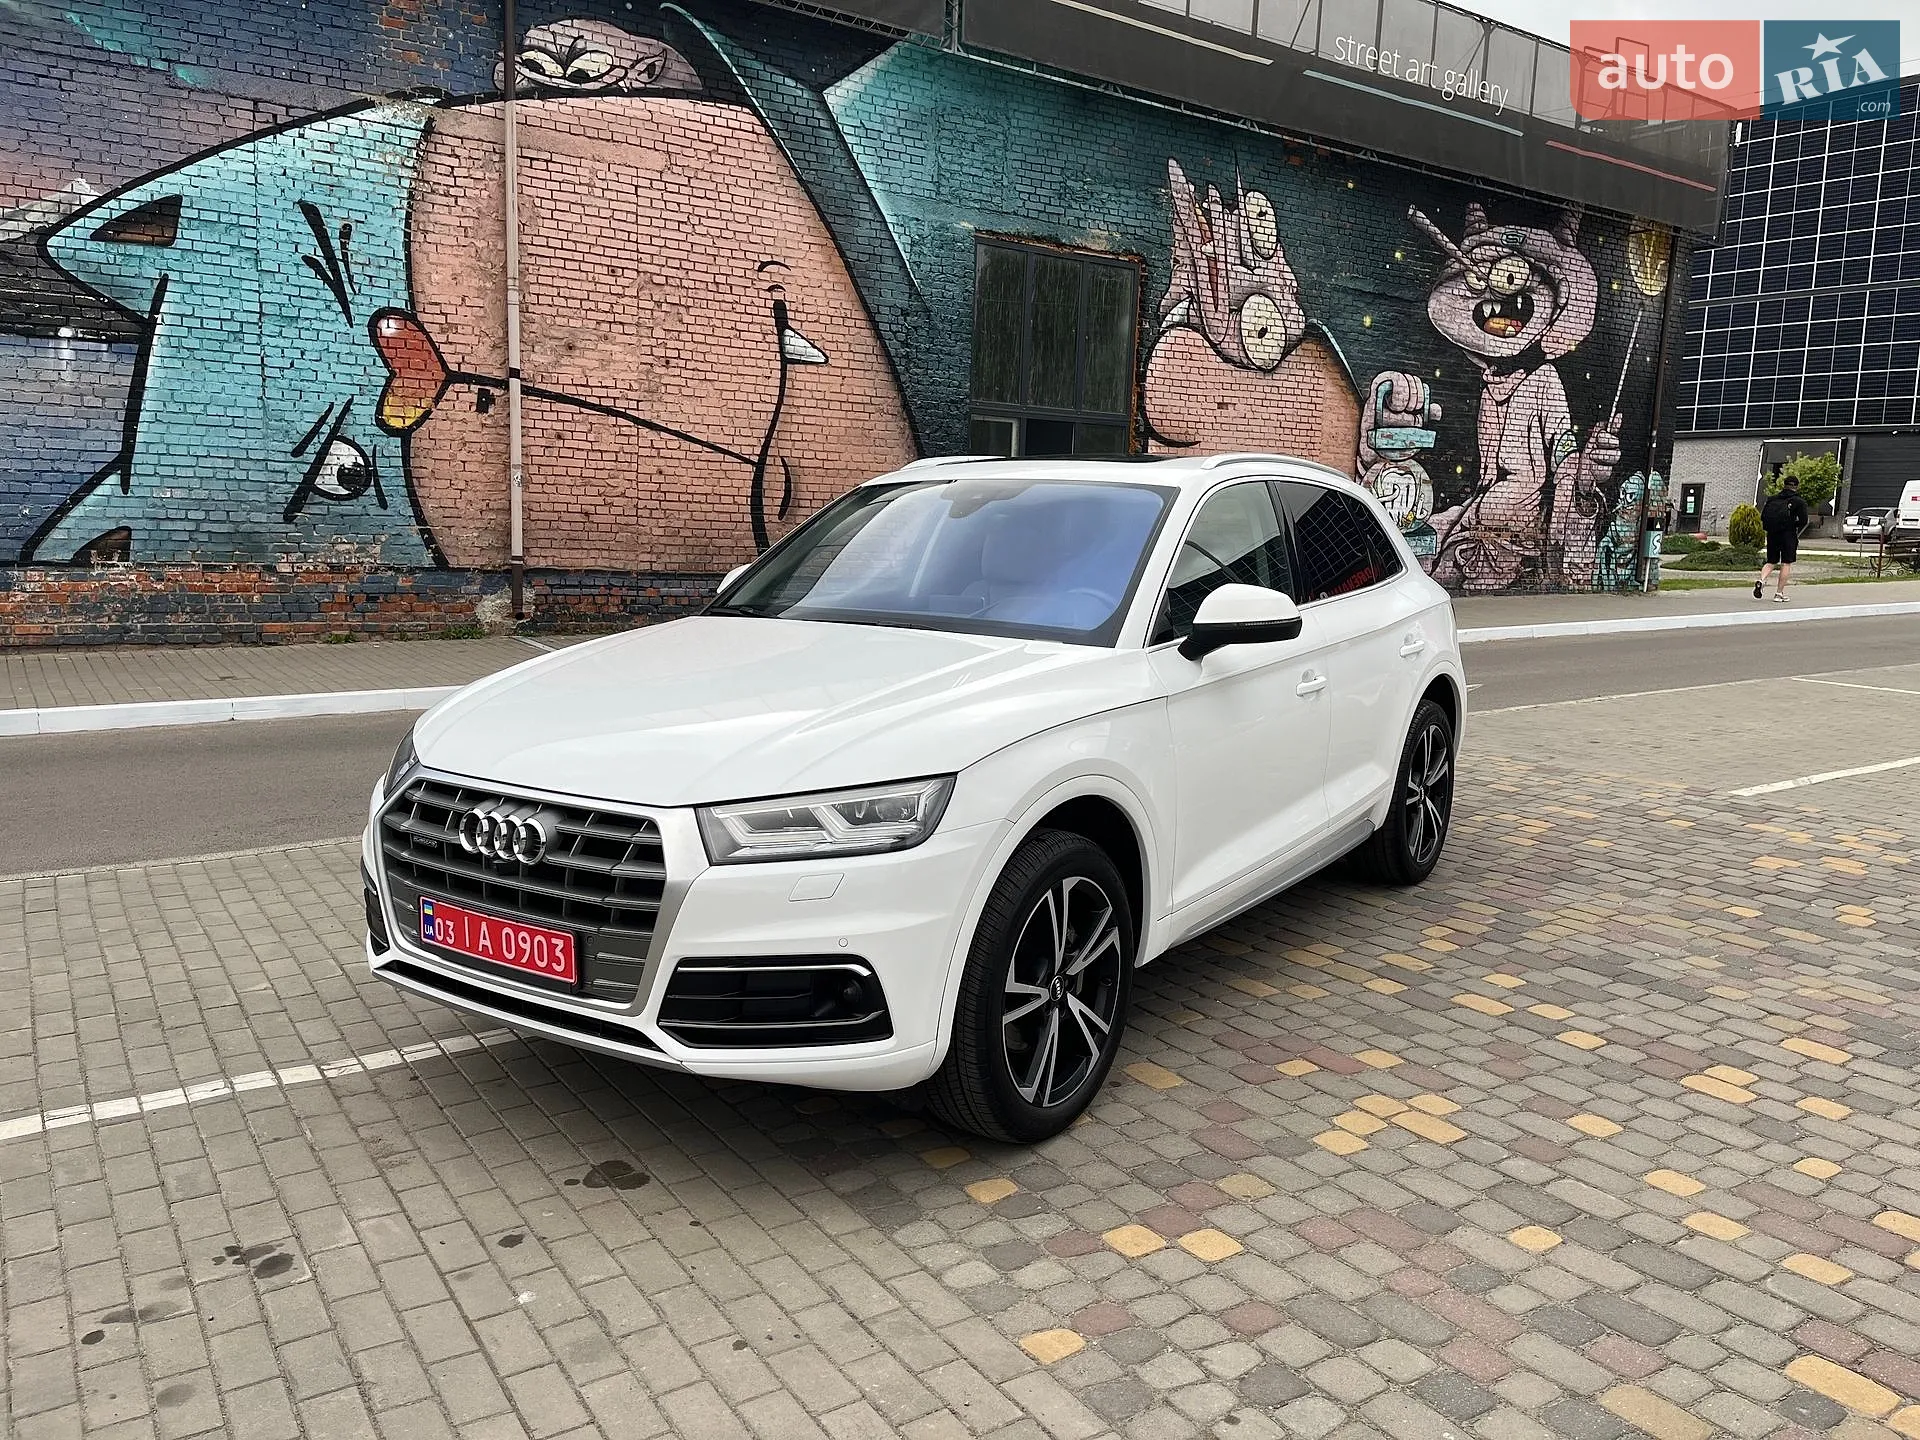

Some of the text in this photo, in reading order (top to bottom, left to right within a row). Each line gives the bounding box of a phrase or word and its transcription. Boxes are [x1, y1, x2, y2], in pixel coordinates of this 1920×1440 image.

[1334, 35, 1509, 116] street art gallery
[424, 923, 434, 936] UA
[435, 917, 455, 945] 03
[501, 926, 566, 973] 0903
